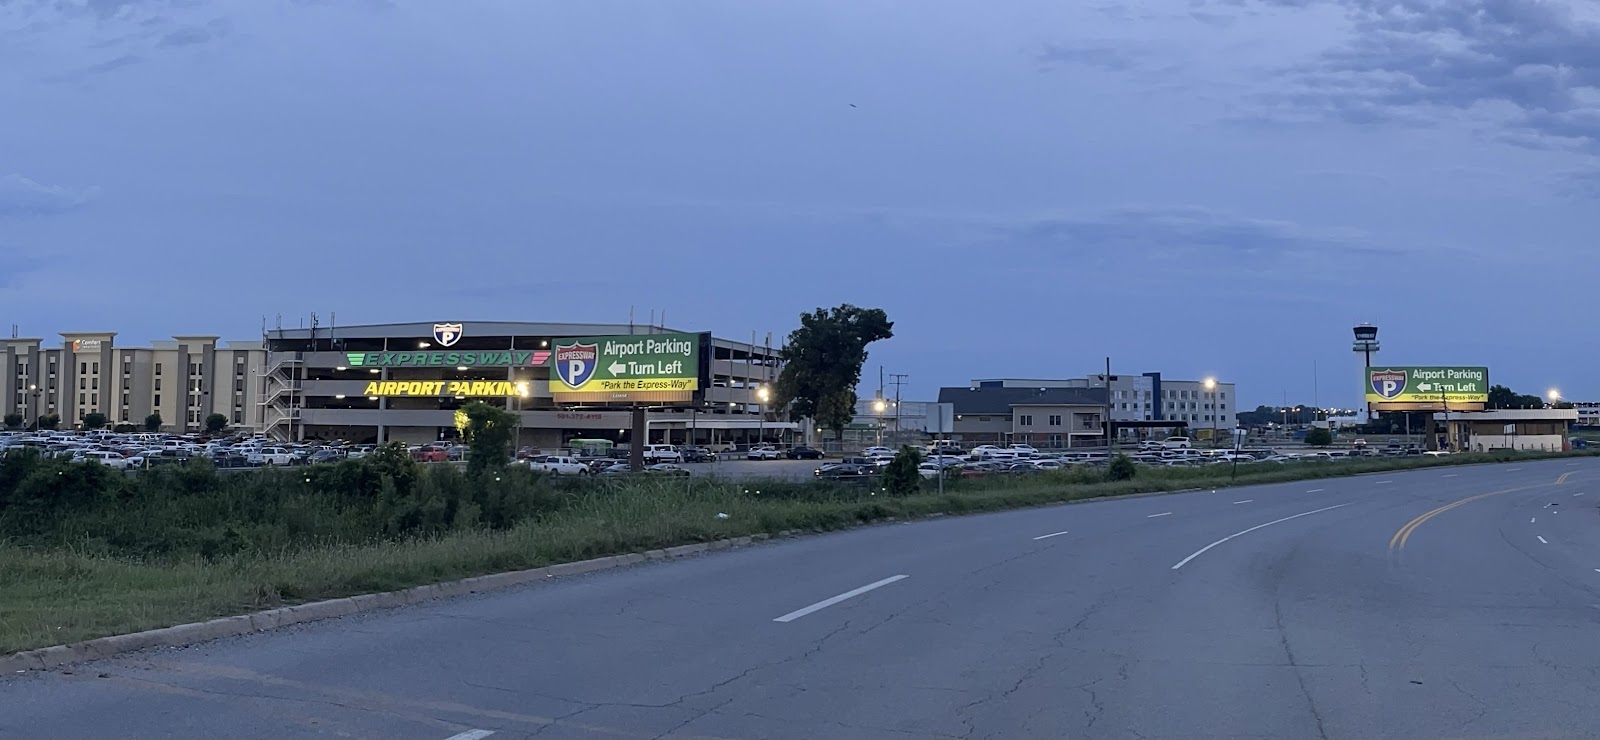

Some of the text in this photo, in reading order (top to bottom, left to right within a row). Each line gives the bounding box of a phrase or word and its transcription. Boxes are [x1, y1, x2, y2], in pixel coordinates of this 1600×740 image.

[442, 332, 455, 344] P
[604, 338, 691, 358] Airport Parking
[365, 352, 531, 366] EXPRESSWAY
[558, 351, 595, 361] EXPRESSWAY
[569, 360, 585, 384] P
[628, 360, 682, 375] Turn Left
[1412, 369, 1482, 381] Airport Parking
[364, 381, 529, 396] AIRPORT PARKIN
[623, 380, 635, 389] the
[1383, 381, 1397, 397] P
[1457, 382, 1476, 391] Left
